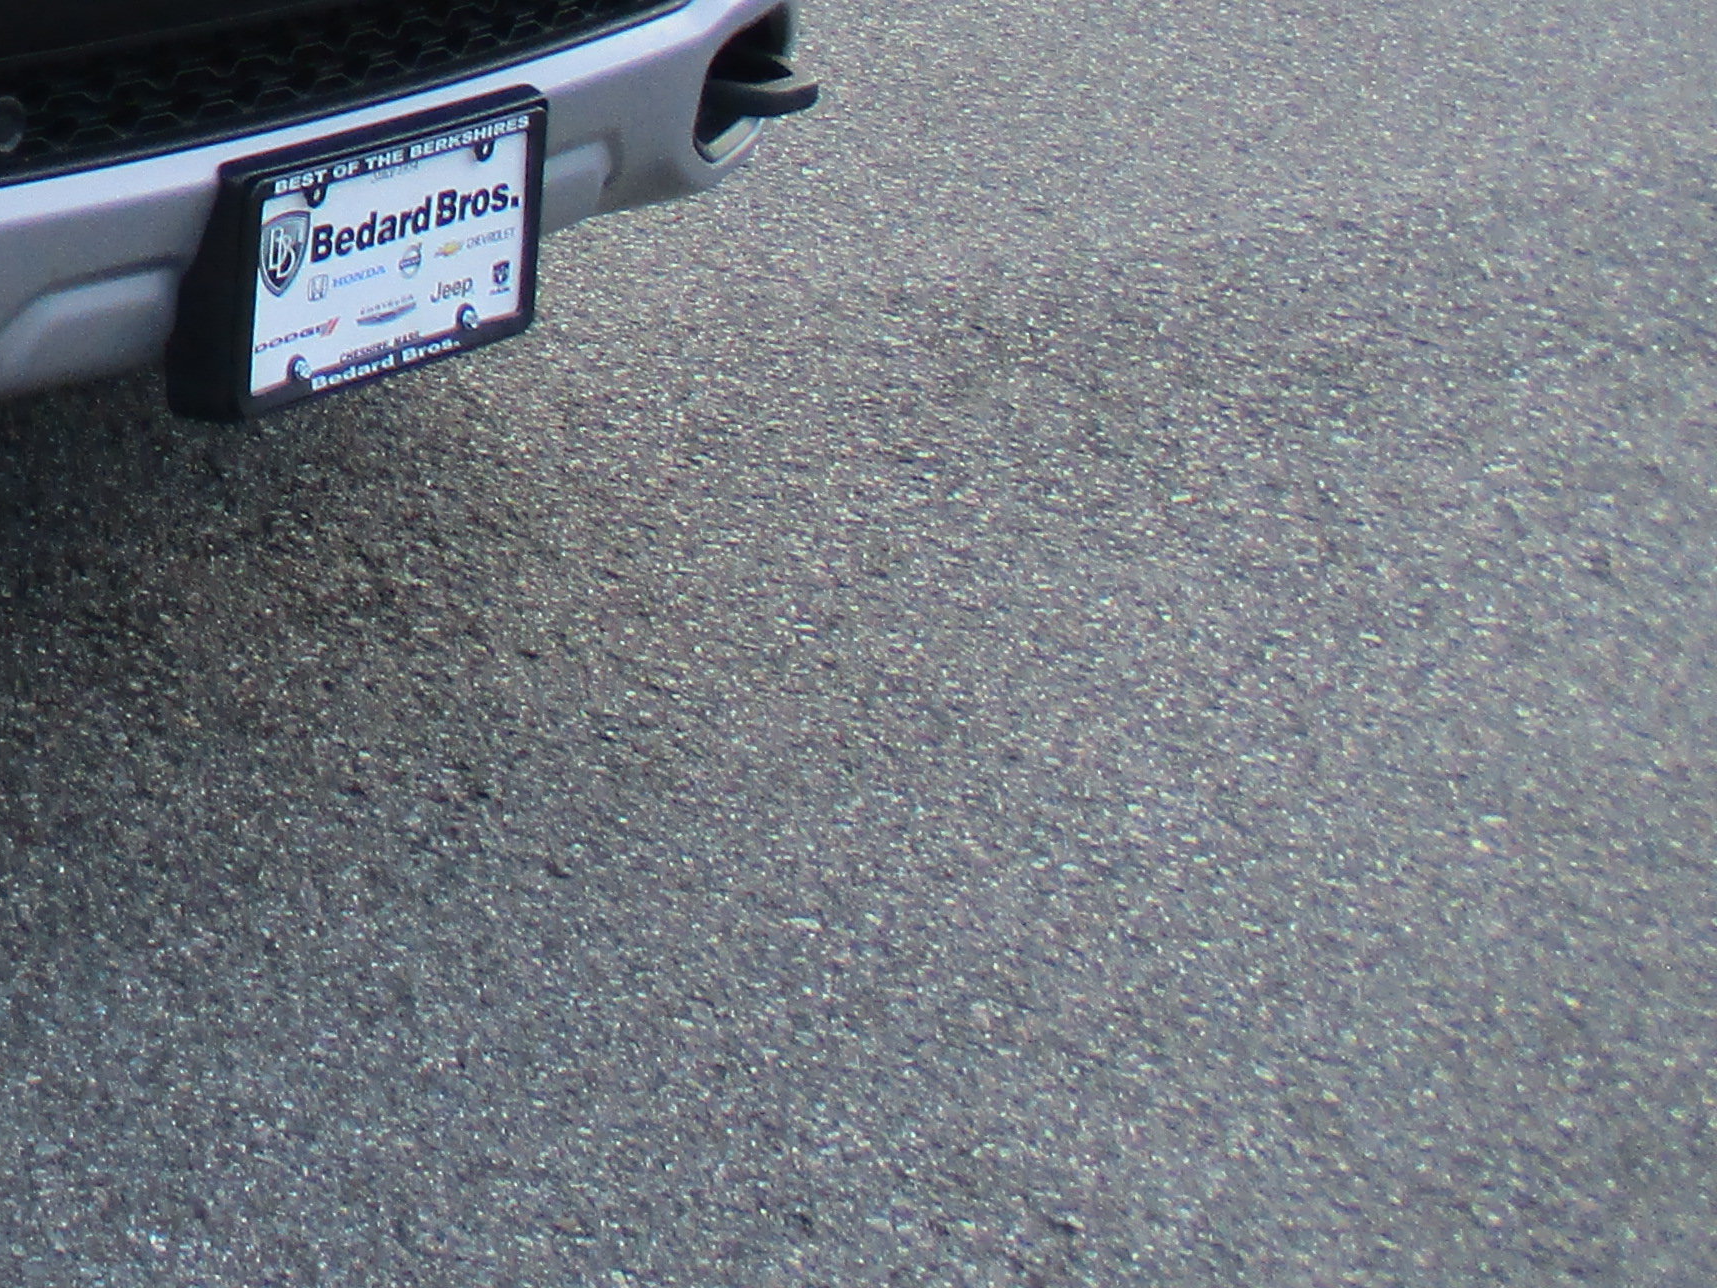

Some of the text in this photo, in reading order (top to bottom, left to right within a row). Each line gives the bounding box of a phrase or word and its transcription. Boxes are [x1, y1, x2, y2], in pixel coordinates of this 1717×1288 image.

[274, 168, 328, 194] BEST
[332, 160, 361, 179] OF
[365, 146, 405, 170] THE
[410, 115, 530, 158] BERKSHIRES
[309, 181, 520, 263] Bedard Bros.
[333, 265, 387, 288] HONDA
[429, 277, 474, 303] Jeep
[311, 337, 461, 391] Bedard Bros.
